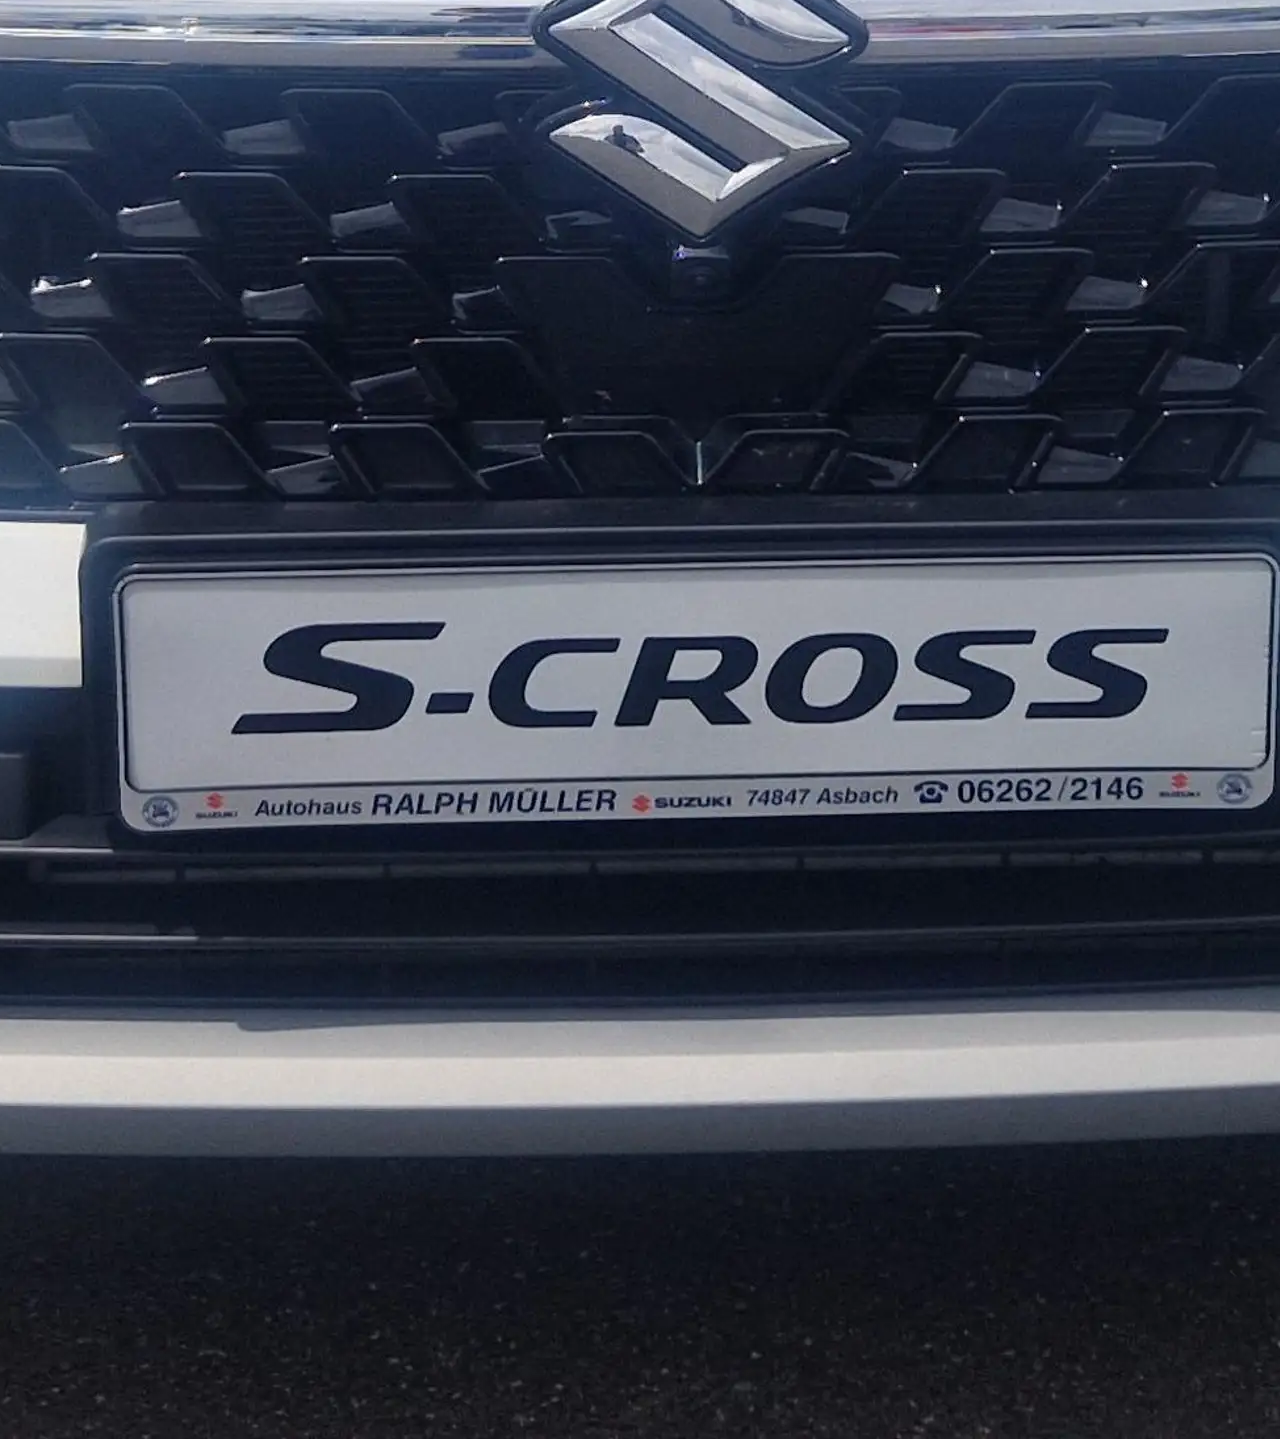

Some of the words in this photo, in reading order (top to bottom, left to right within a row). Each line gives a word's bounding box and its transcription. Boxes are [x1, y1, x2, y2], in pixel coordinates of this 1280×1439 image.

[231, 621, 1170, 735] S-CROSS
[254, 798, 363, 817] Autohaus
[371, 791, 479, 817] RALPH
[488, 786, 618, 814] MÜLLER
[654, 795, 733, 810] SUZUKI
[746, 788, 811, 807] 74847
[816, 785, 900, 805] Asbach
